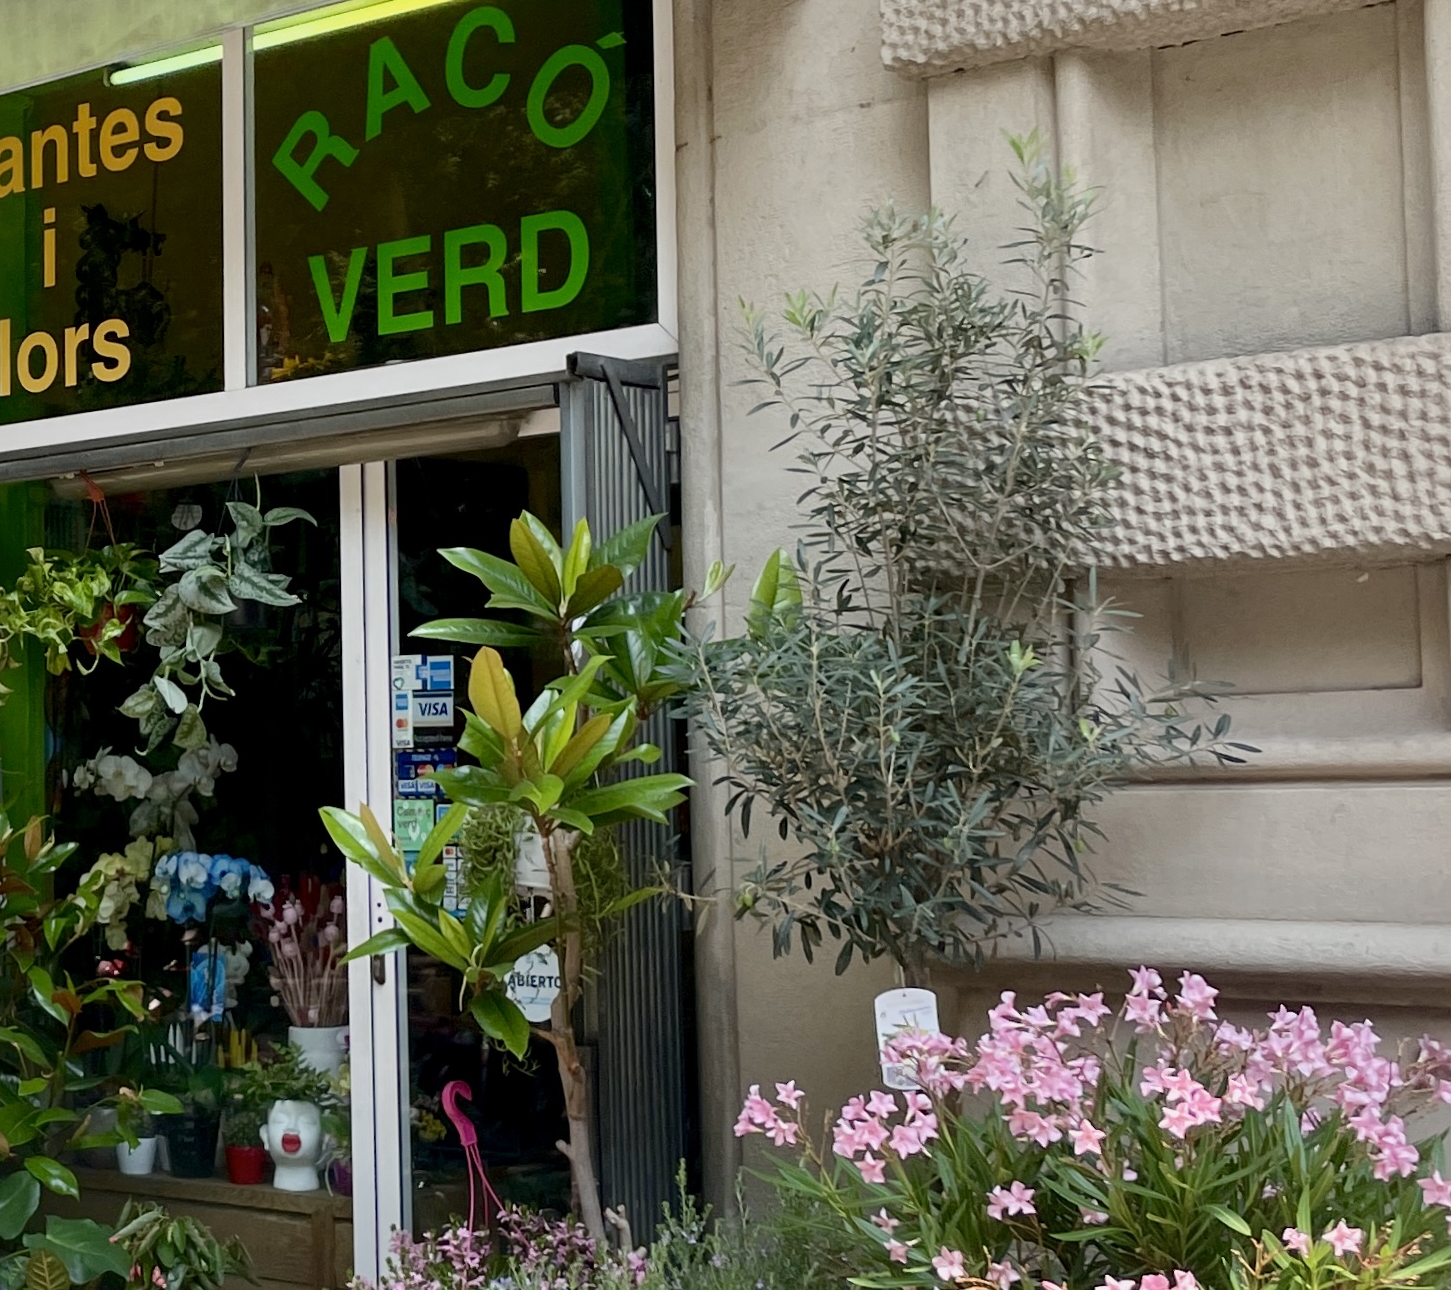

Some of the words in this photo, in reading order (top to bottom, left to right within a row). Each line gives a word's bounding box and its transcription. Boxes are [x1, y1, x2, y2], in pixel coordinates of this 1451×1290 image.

[271, 5, 627, 211] RACÓ
[42, 207, 57, 289] i
[306, 209, 590, 343] VERD
[418, 701, 449, 717] VISA
